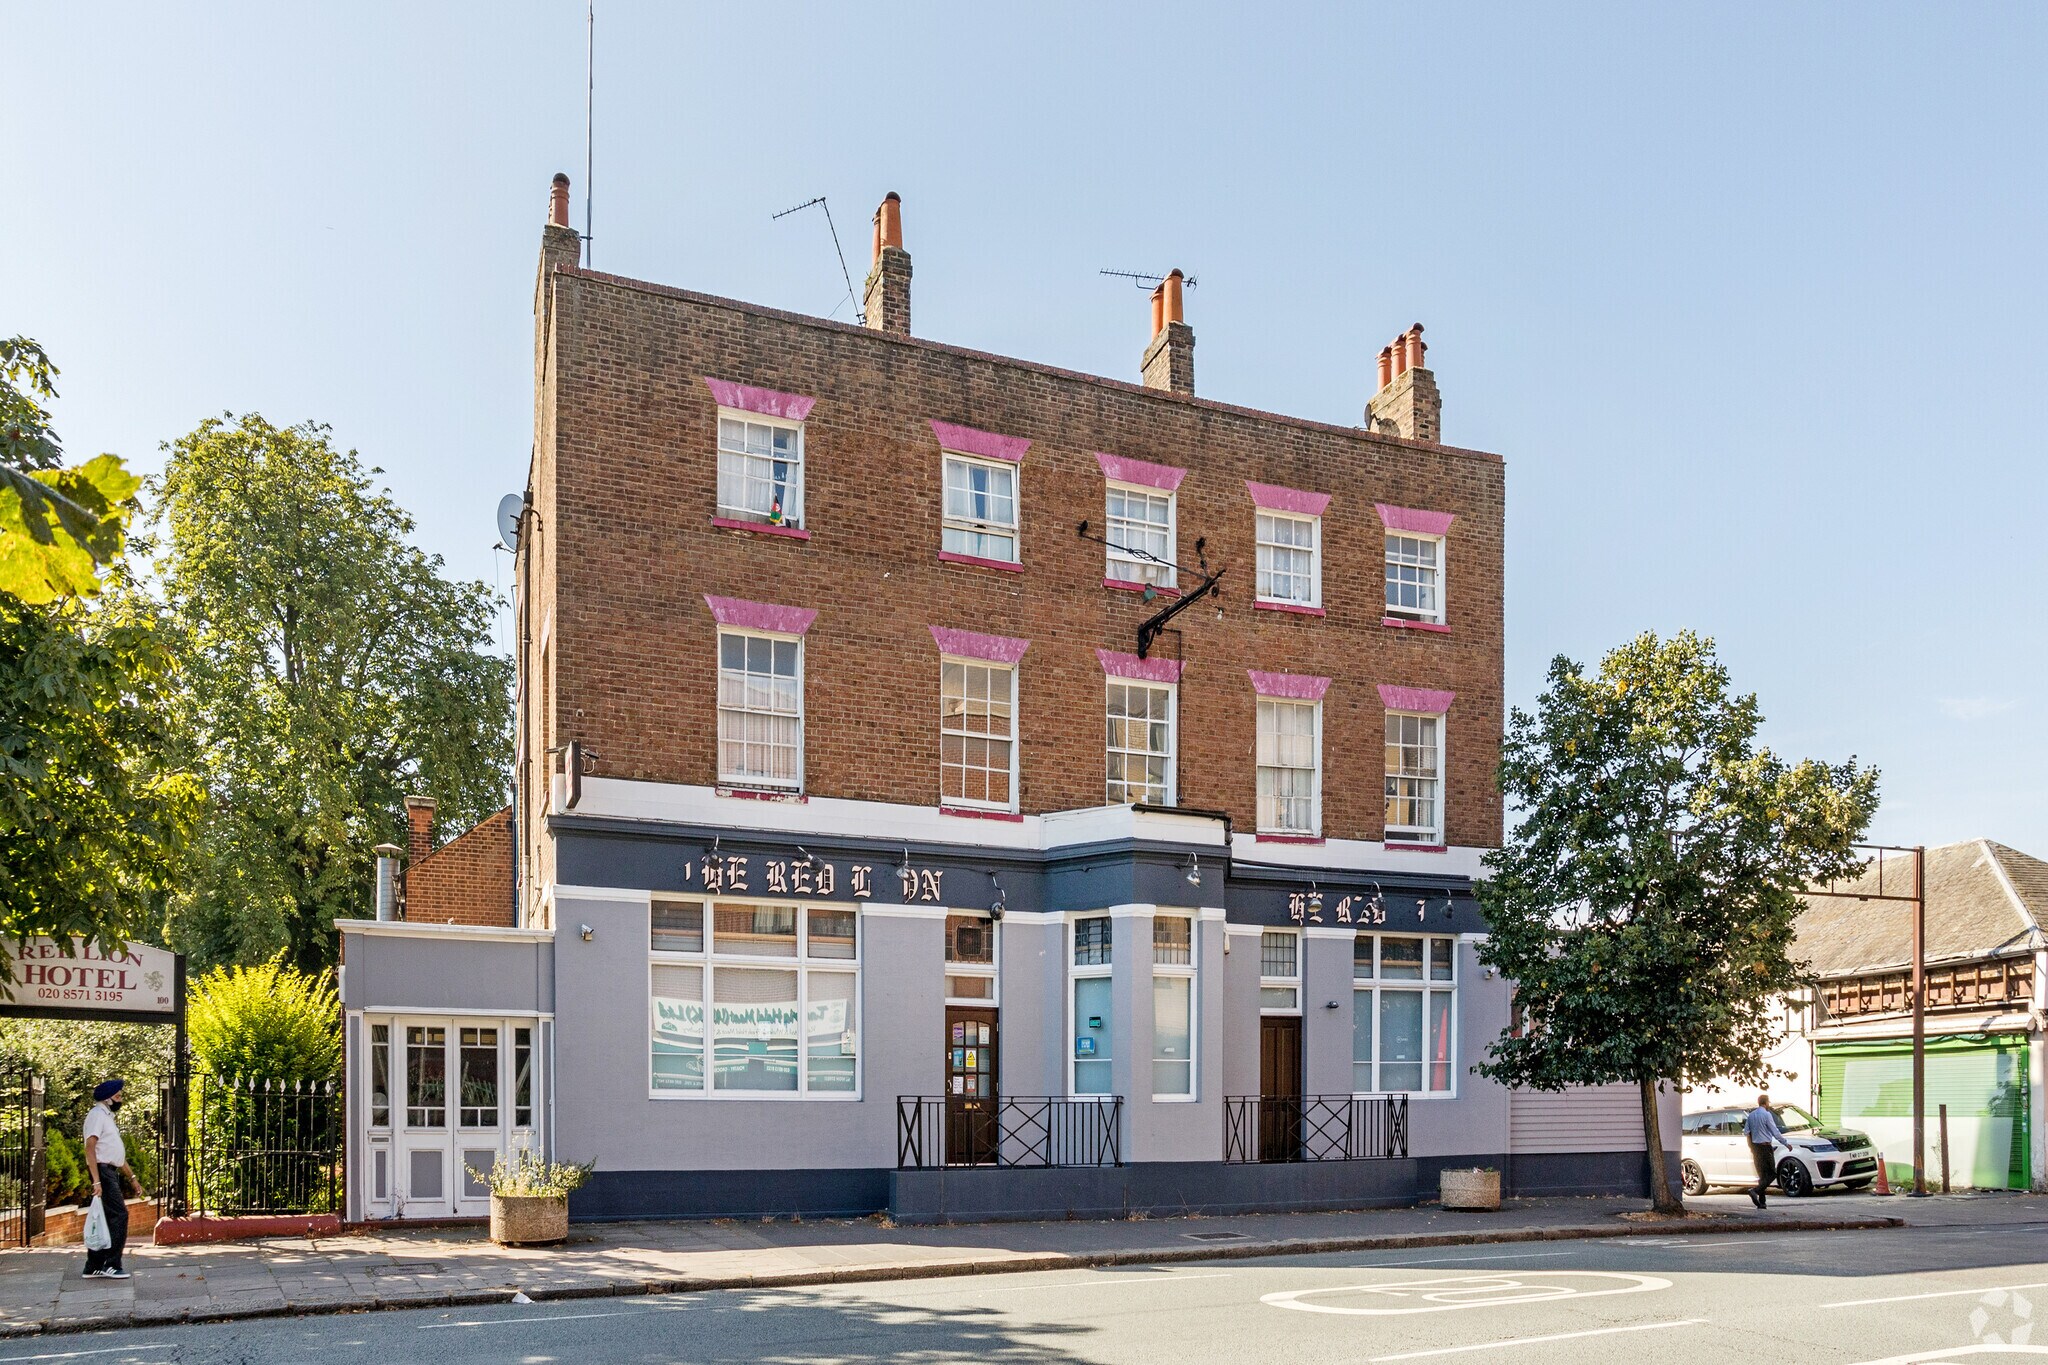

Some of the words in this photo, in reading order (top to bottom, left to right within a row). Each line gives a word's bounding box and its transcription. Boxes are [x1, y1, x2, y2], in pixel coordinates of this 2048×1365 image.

[766, 861, 834, 895] RED
[23, 964, 137, 990] HOTEL
[38, 988, 60, 999] 020
[63, 989, 91, 1001] 8571
[95, 991, 123, 1002] 3195
